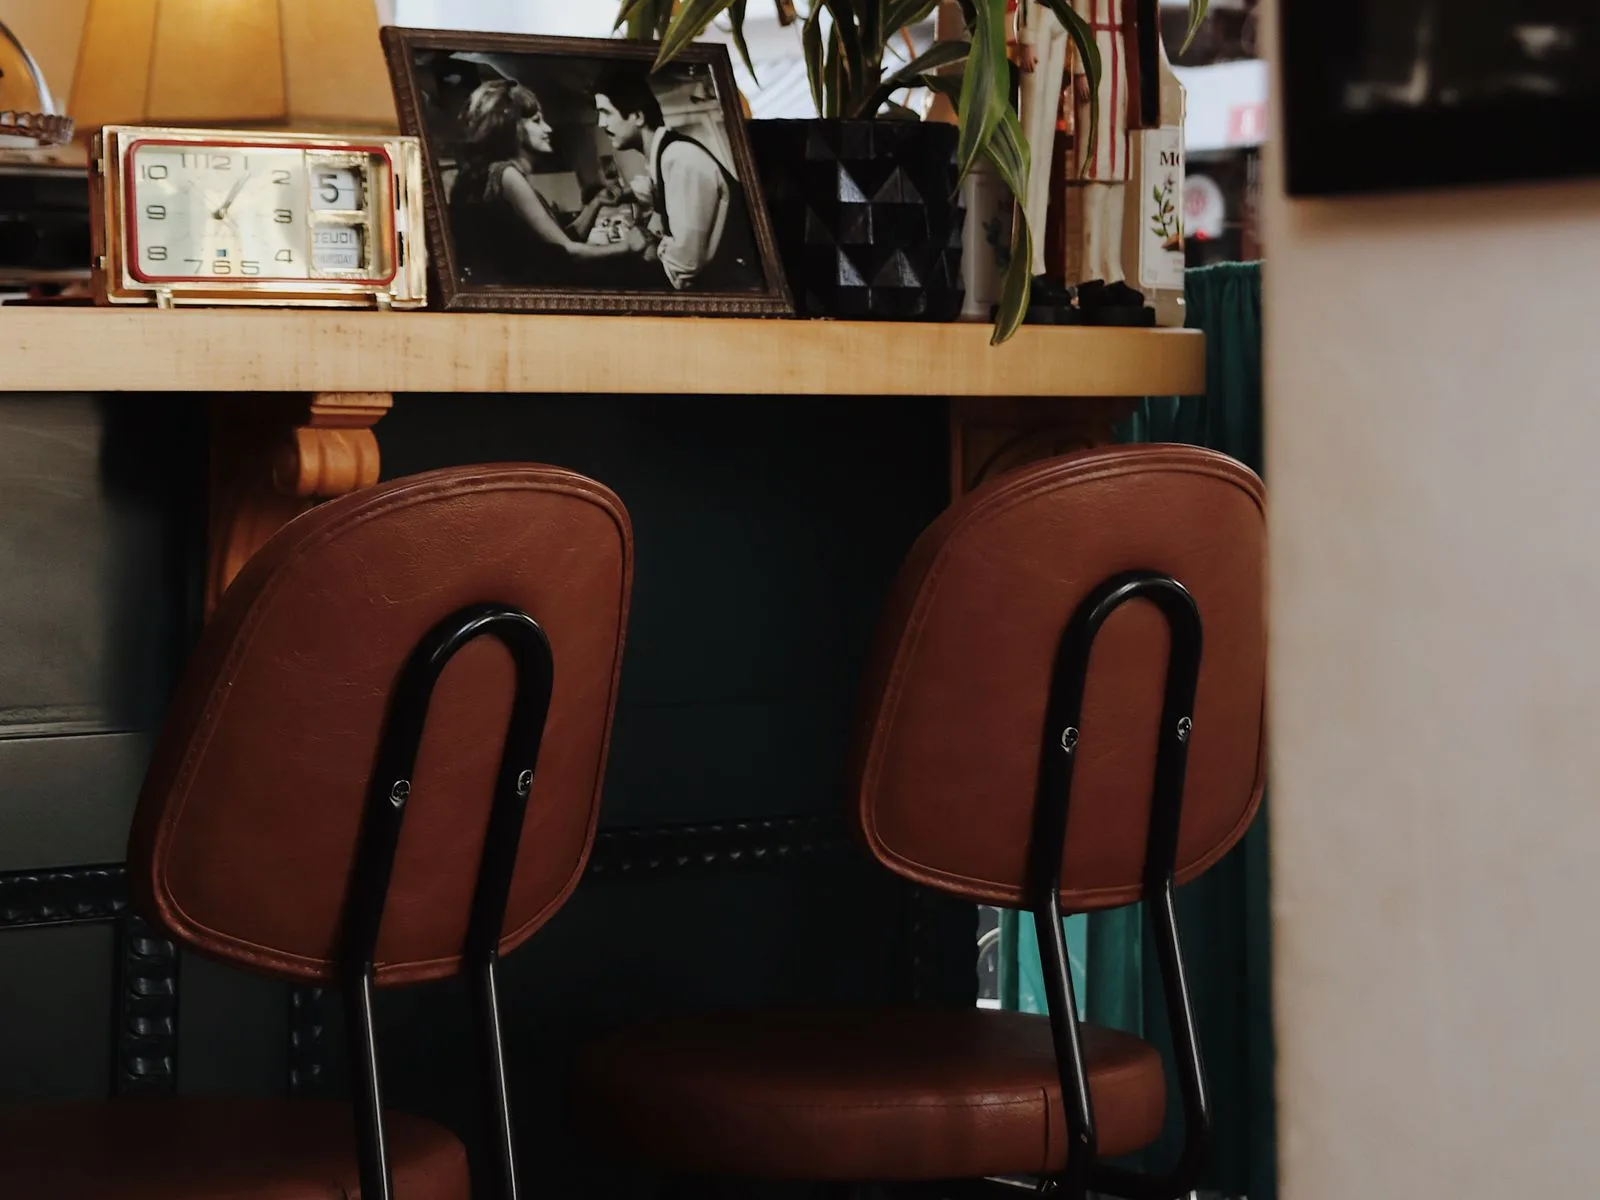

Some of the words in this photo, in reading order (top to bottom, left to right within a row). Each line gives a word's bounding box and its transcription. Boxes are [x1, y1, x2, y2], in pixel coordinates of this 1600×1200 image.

[181, 153, 198, 169] 11
[205, 154, 231, 171] 12
[141, 164, 168, 180] 10
[272, 170, 291, 185] 2
[318, 174, 339, 204] 5
[146, 205, 167, 220] 9
[273, 209, 292, 224] 3
[147, 246, 168, 261] 8
[274, 249, 293, 263] 4
[183, 259, 203, 274] 7
[212, 260, 231, 275] 6
[240, 260, 260, 275] 5
